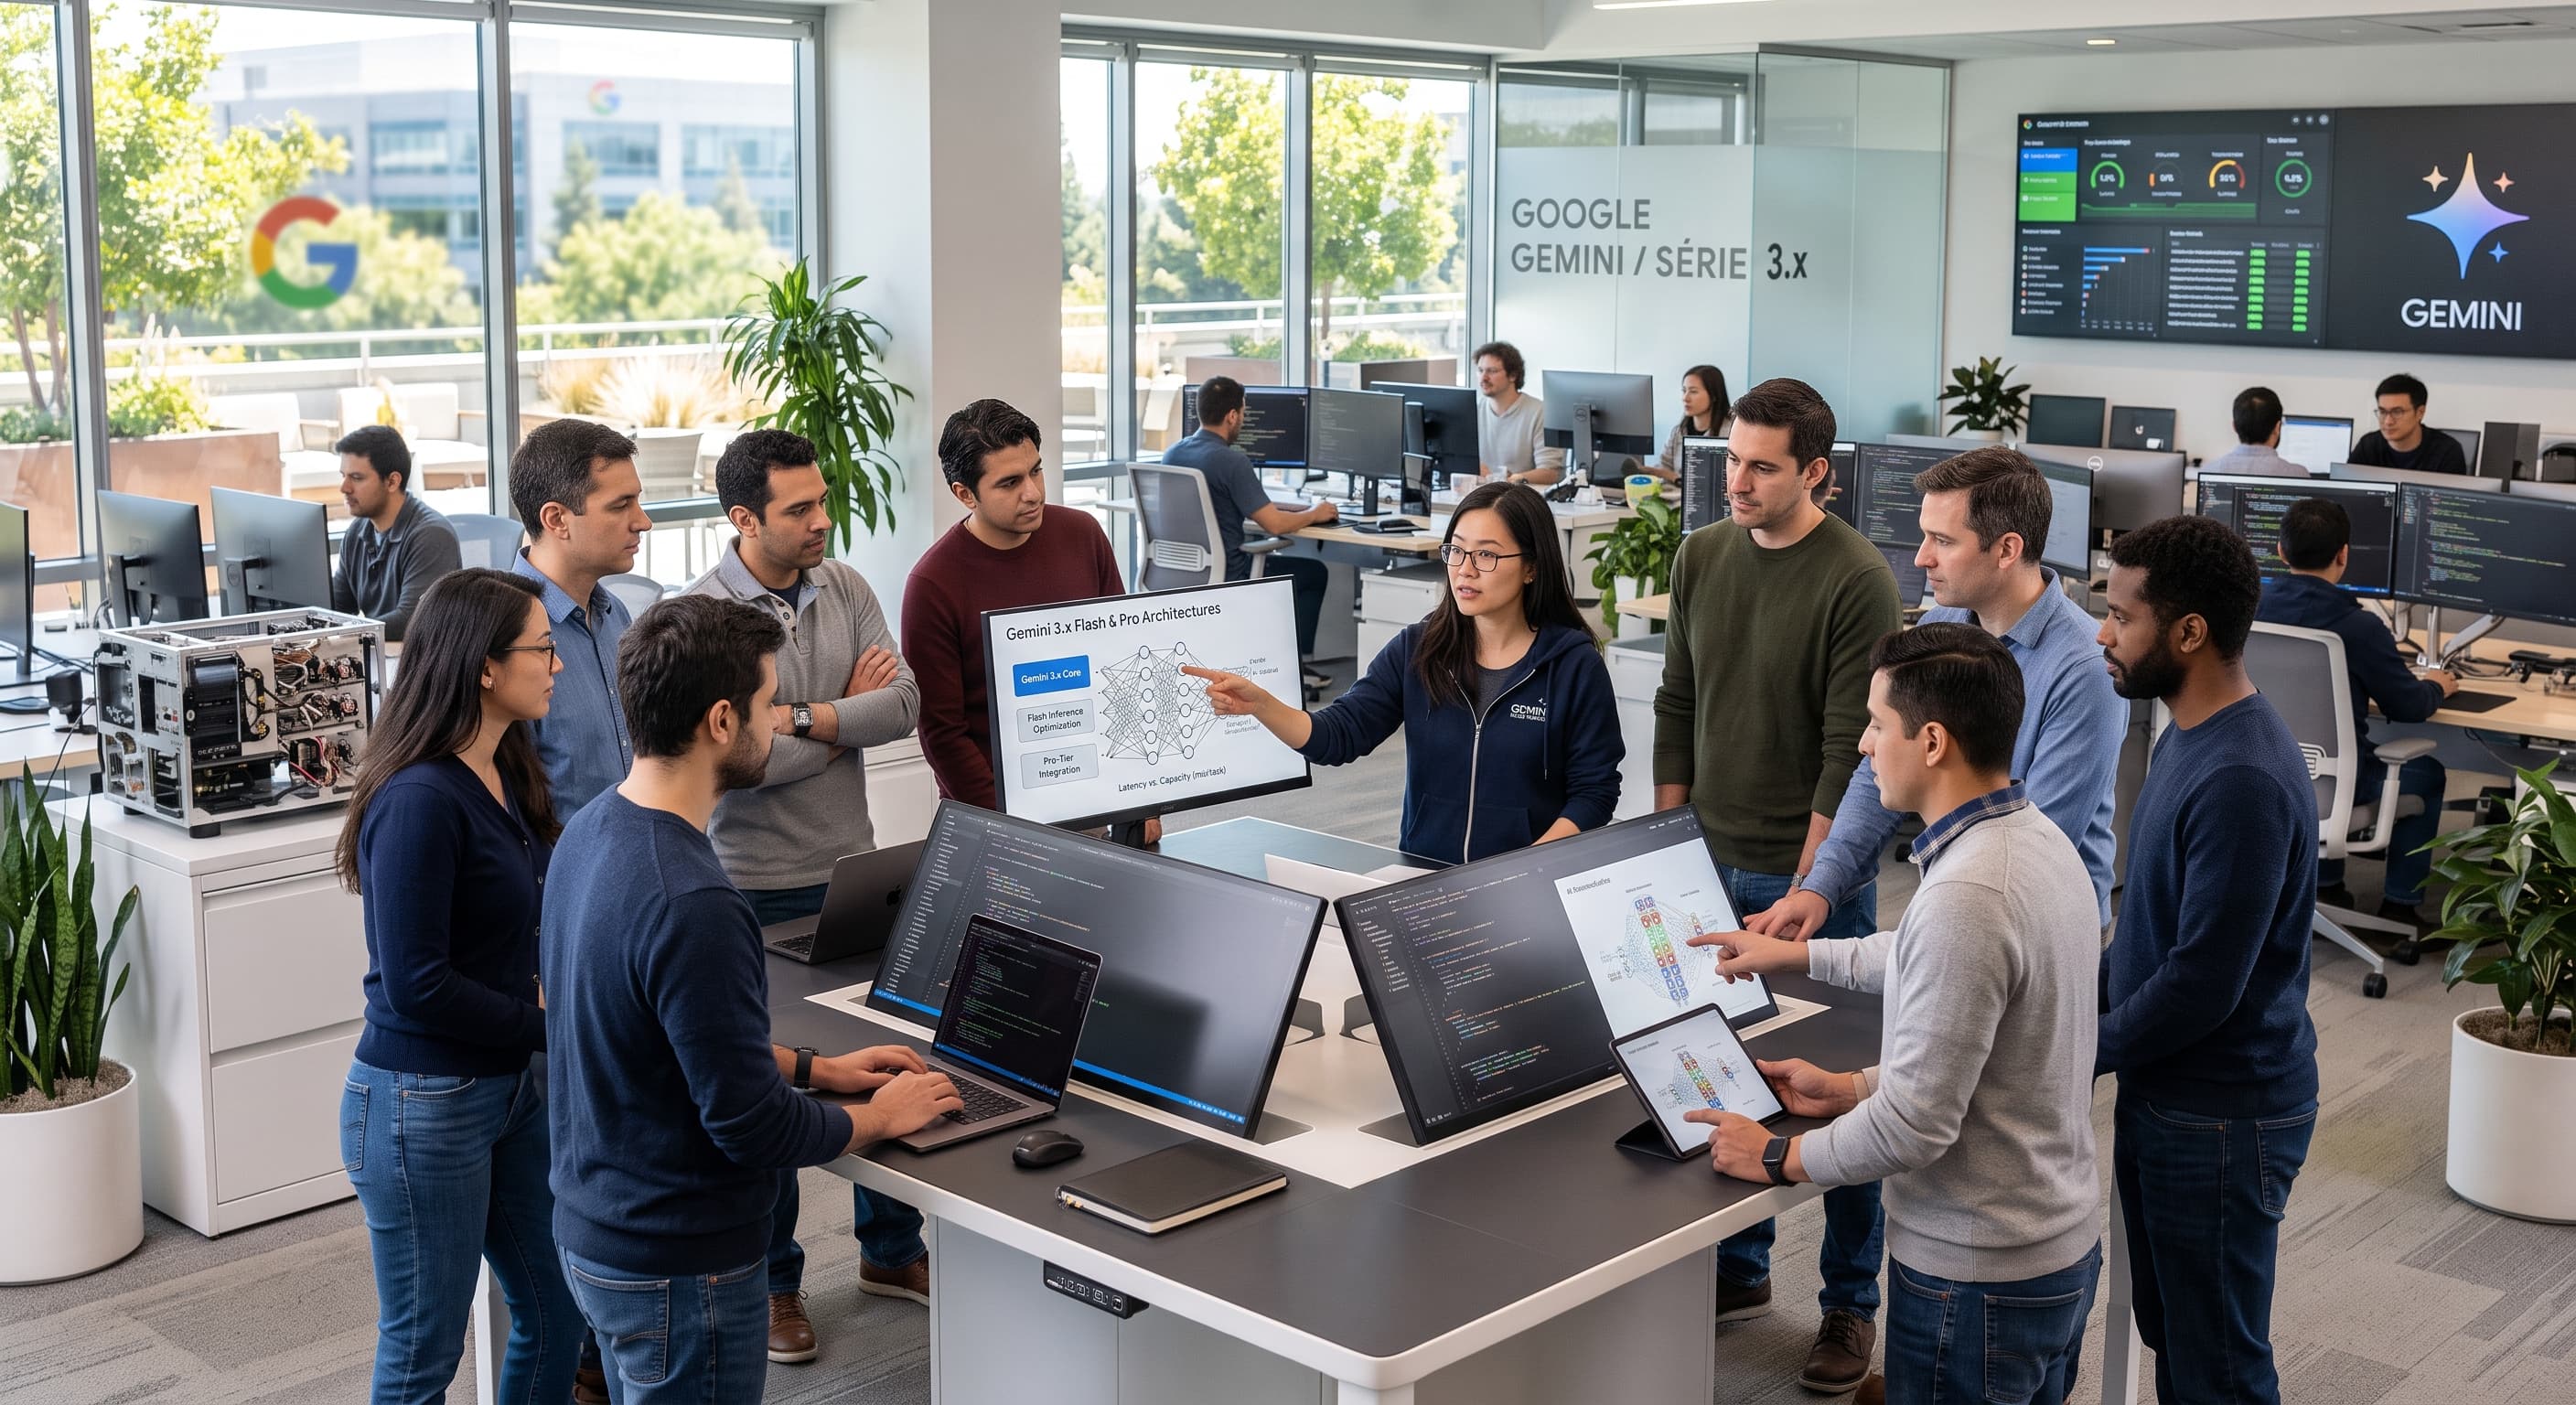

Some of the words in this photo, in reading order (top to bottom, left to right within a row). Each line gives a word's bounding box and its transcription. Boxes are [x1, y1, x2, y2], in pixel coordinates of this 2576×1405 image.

[1511, 198, 1651, 231] GOOGLE
[251, 195, 359, 309] G
[1511, 242, 1624, 275] GEMINI
[1633, 245, 1648, 276] /
[1656, 238, 1748, 280] SÉRIE
[1766, 242, 1809, 280] 3.x
[2400, 298, 2523, 331] GEMINI
[1006, 623, 1051, 640] Gemini
[1054, 622, 1072, 635] 3.x
[1075, 617, 1106, 632] Flash
[1109, 614, 1118, 627] &
[1119, 613, 1140, 627] Pro
[1143, 604, 1221, 624] Architectures
[1021, 671, 1049, 684] Gemini
[1050, 671, 1062, 681] 3.x
[1062, 670, 1082, 679] Core
[1027, 712, 1047, 723] Flash
[1048, 708, 1084, 719] Inference
[1033, 720, 1081, 735] Optimization
[1043, 755, 1074, 766] Pro-Tier
[1039, 766, 1081, 778] Integration
[1118, 780, 1147, 792] Latency
[1149, 778, 1158, 787] vs.
[1159, 772, 1191, 786] Capacity
